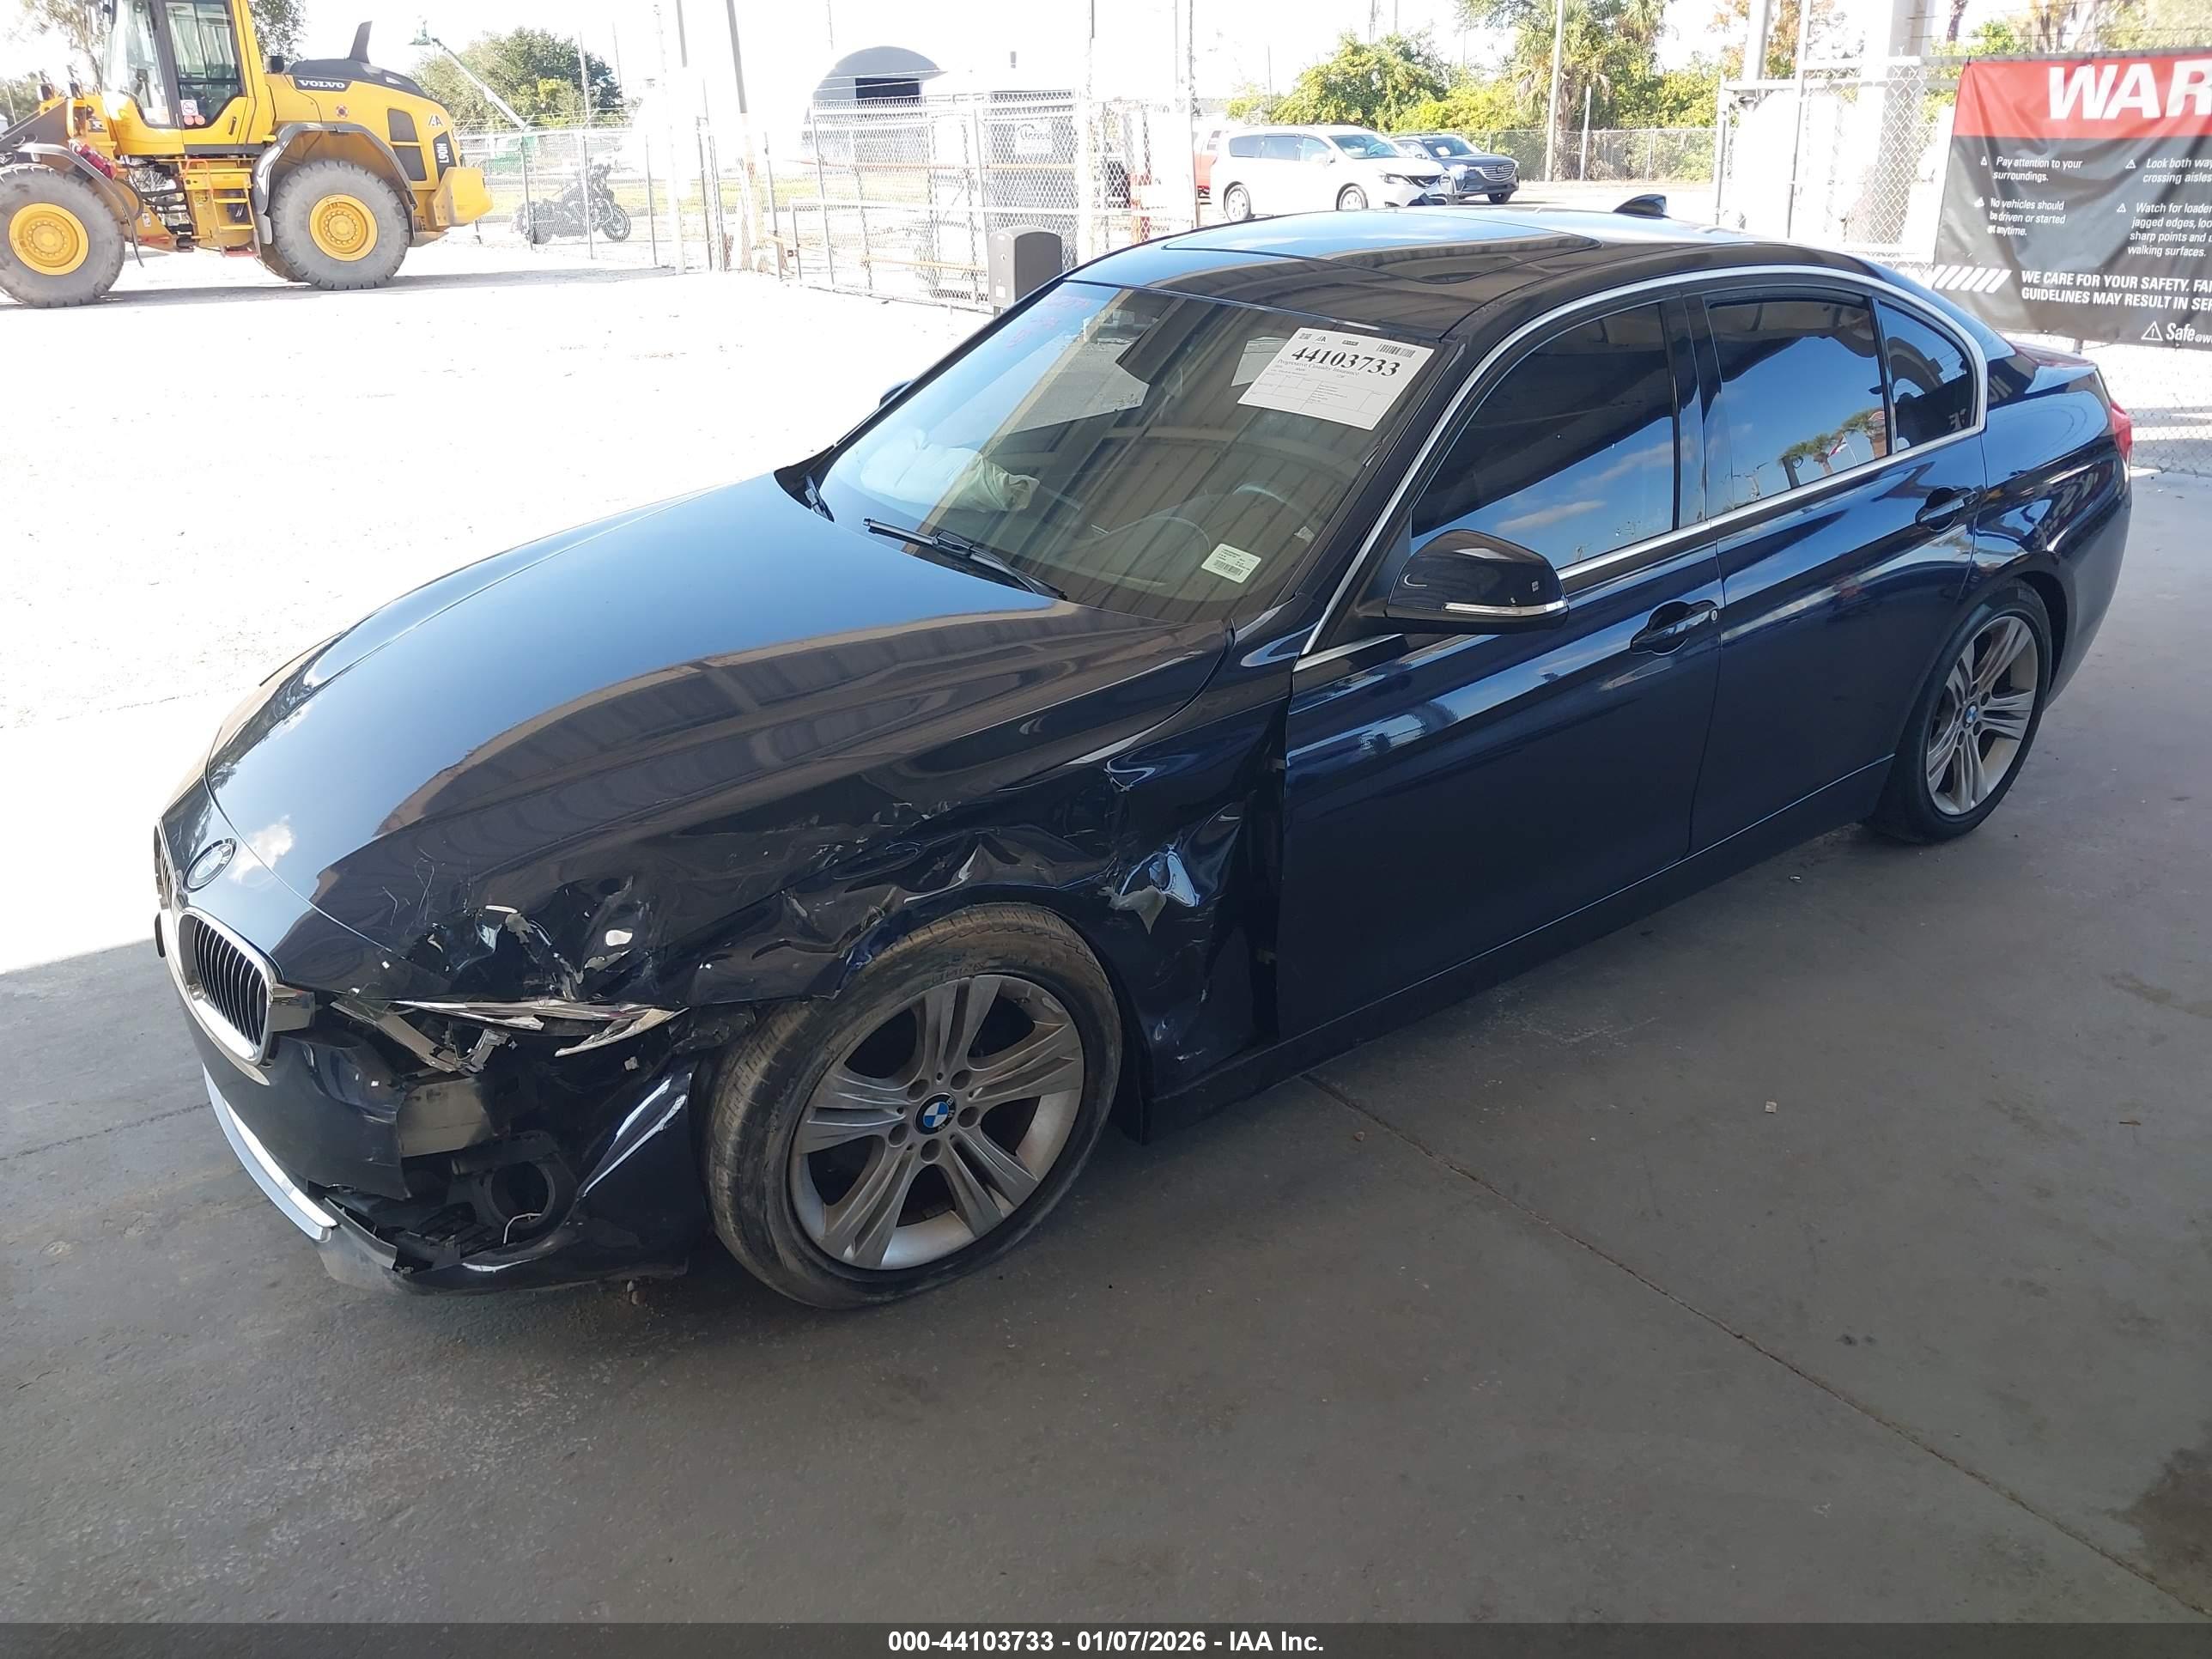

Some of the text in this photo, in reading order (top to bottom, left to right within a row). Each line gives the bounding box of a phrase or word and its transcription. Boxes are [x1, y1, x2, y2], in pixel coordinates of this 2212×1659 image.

[298, 79, 345, 89] VOLVO
[2049, 58, 2212, 119] WAR
[436, 143, 449, 163] L90H
[1996, 155, 2082, 170] Pay attention to your
[2147, 158, 2167, 168] Look
[2169, 157, 2191, 168] both
[1992, 172, 2049, 183] surroundings.
[2142, 172, 2212, 185] crossing aisles
[1990, 198, 2065, 210] No vehicles should
[2136, 202, 2166, 214] Watch
[2168, 203, 2183, 214] for
[1998, 212, 2023, 222] driven
[2035, 214, 2066, 224] started
[2131, 216, 2164, 229] jagged
[2166, 218, 2197, 230] edges,
[1996, 226, 2027, 236] anytime.
[2130, 231, 2156, 244] sharp
[2158, 232, 2188, 243] points
[2189, 233, 2207, 243] and
[2128, 246, 2207, 258] walking surfaces.
[2021, 270, 2040, 283] WE
[2043, 272, 2074, 286] CARE
[2076, 274, 2100, 288] FOR
[2104, 275, 2138, 289] YOUR
[2141, 276, 2190, 292] SAFETY.
[2021, 288, 2090, 305] GUIDELINES
[2093, 292, 2124, 307] MAY
[2124, 294, 2172, 310] RESULT
[2172, 296, 2189, 310] IN
[1291, 346, 1401, 377] 44103733
